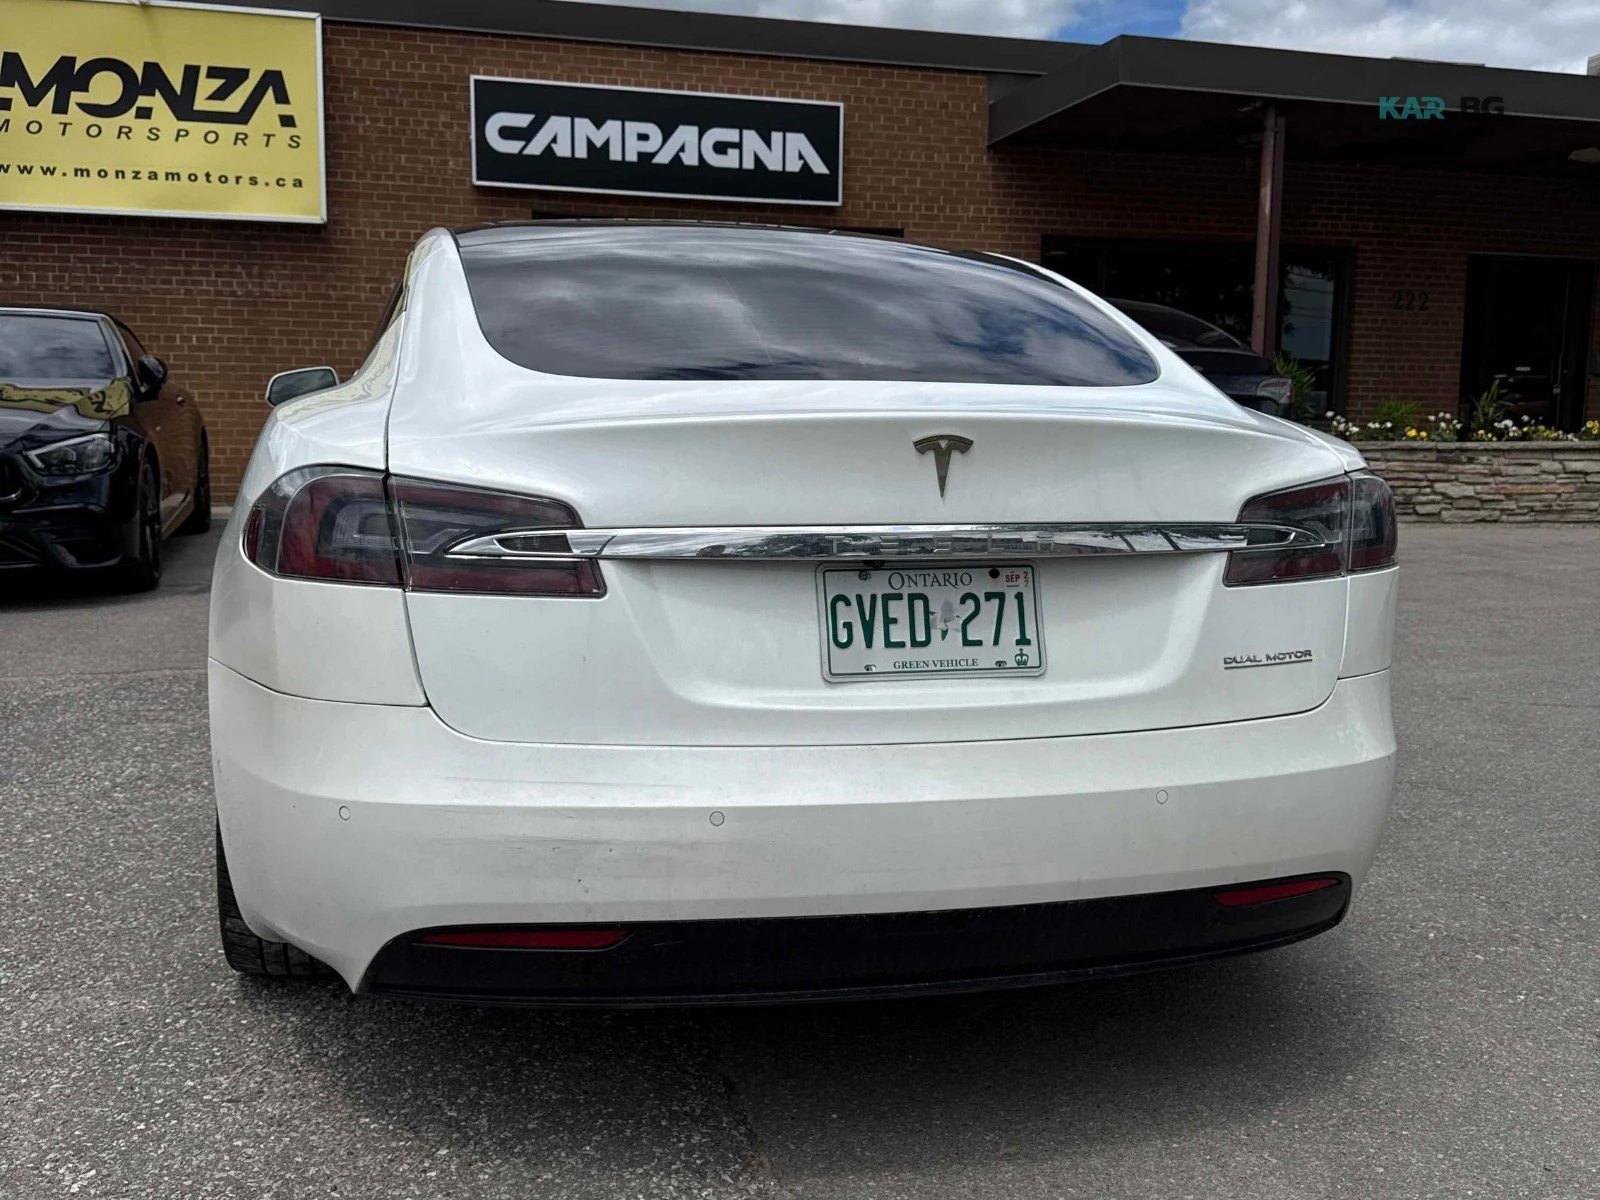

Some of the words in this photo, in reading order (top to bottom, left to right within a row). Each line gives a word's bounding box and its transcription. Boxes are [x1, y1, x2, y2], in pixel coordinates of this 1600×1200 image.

[0, 51, 297, 129] MONZA
[484, 111, 831, 175] CAMPAGNA
[1392, 290, 1429, 311] 222
[888, 571, 973, 591] ONTARIO
[1004, 573, 1021, 583] SEP
[829, 592, 932, 649] GVED
[959, 591, 1032, 647] 271
[893, 660, 930, 670] GREEN
[932, 658, 979, 669] VEHICLE
[1223, 654, 1263, 665] DUAL
[1265, 649, 1313, 662] MOTOR
